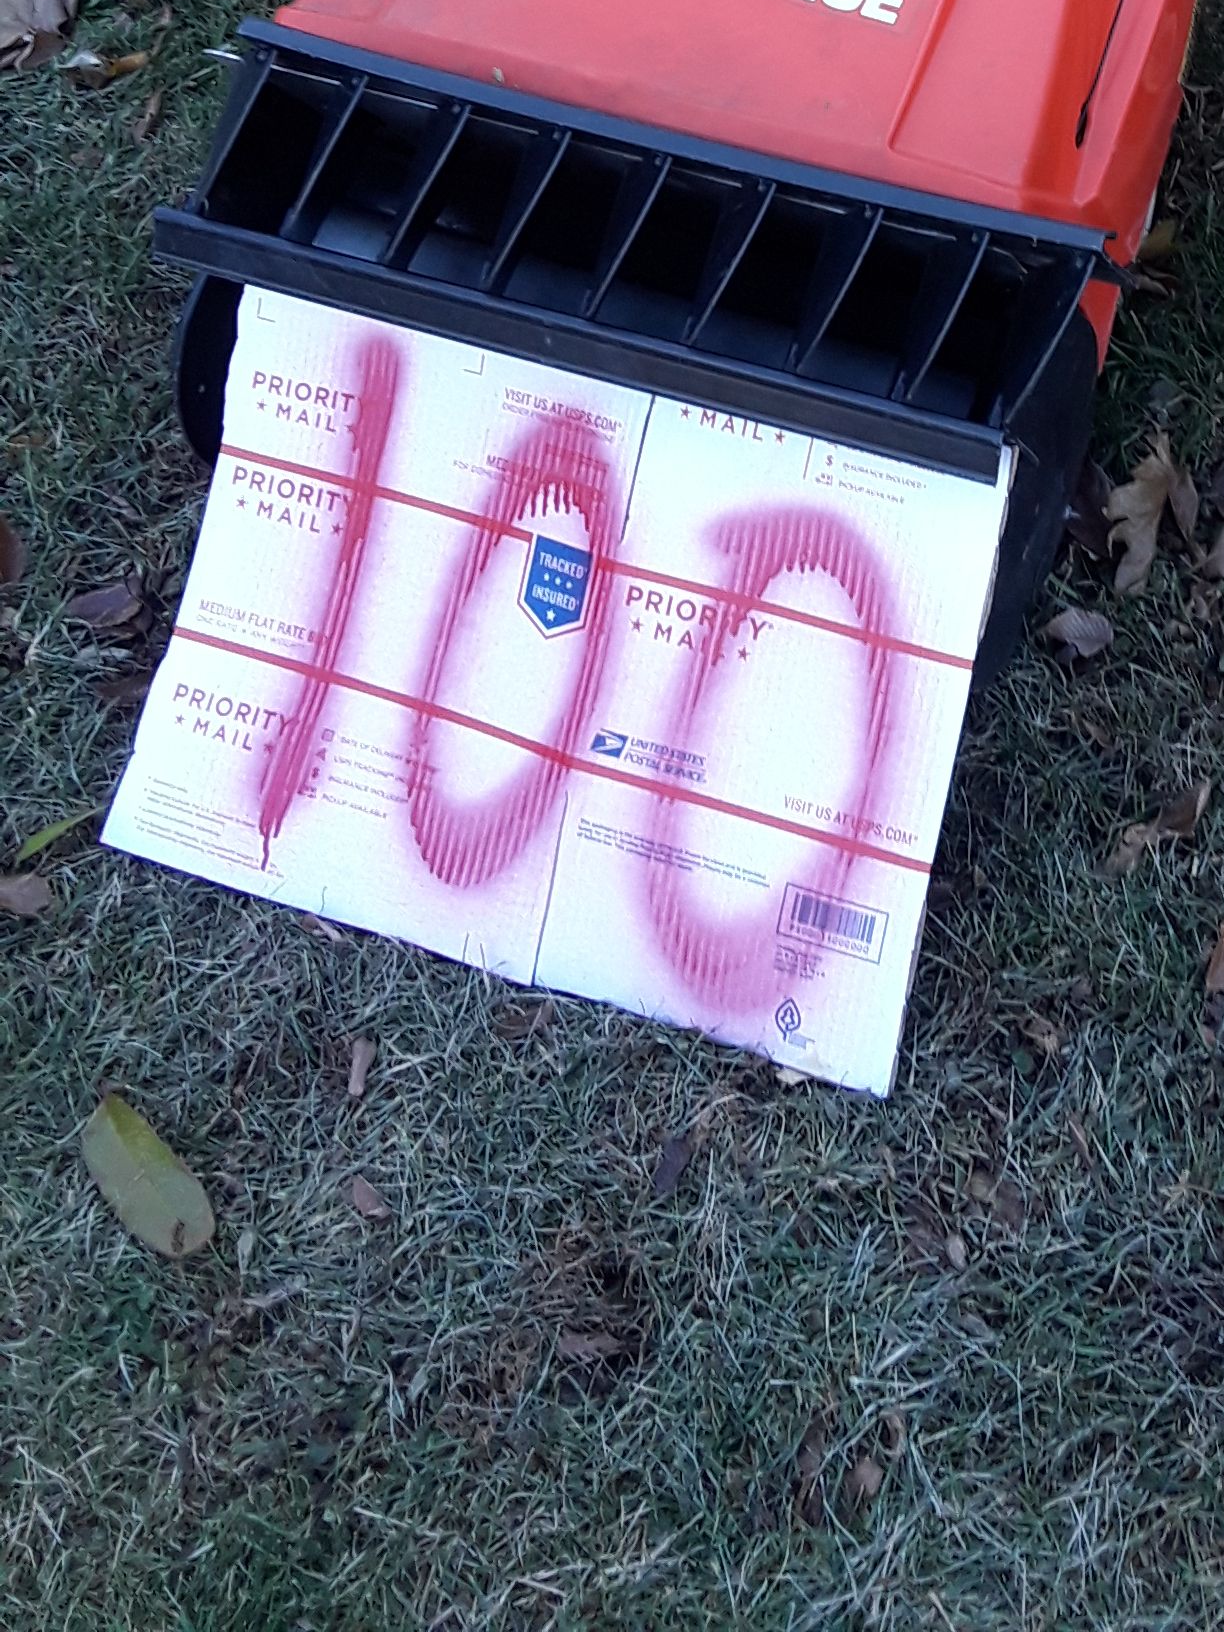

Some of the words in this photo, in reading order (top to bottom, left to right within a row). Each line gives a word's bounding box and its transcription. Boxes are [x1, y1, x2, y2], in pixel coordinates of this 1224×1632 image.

[504, 386, 533, 407] VISIT
[533, 395, 549, 412] US
[550, 400, 565, 416] AT
[275, 402, 337, 433] MAIL
[699, 409, 763, 442] MAIL
[256, 499, 321, 534] MAIL
[538, 550, 585, 579] TRACKED
[531, 583, 577, 612] INSURED
[248, 612, 276, 631] FLAT
[276, 621, 307, 641] RATE
[258, 328, 906, 1018] 100
[193, 717, 253, 752] MAIL
[783, 794, 814, 815] VISIT
[814, 804, 833, 821] US
[833, 810, 849, 827] AT
